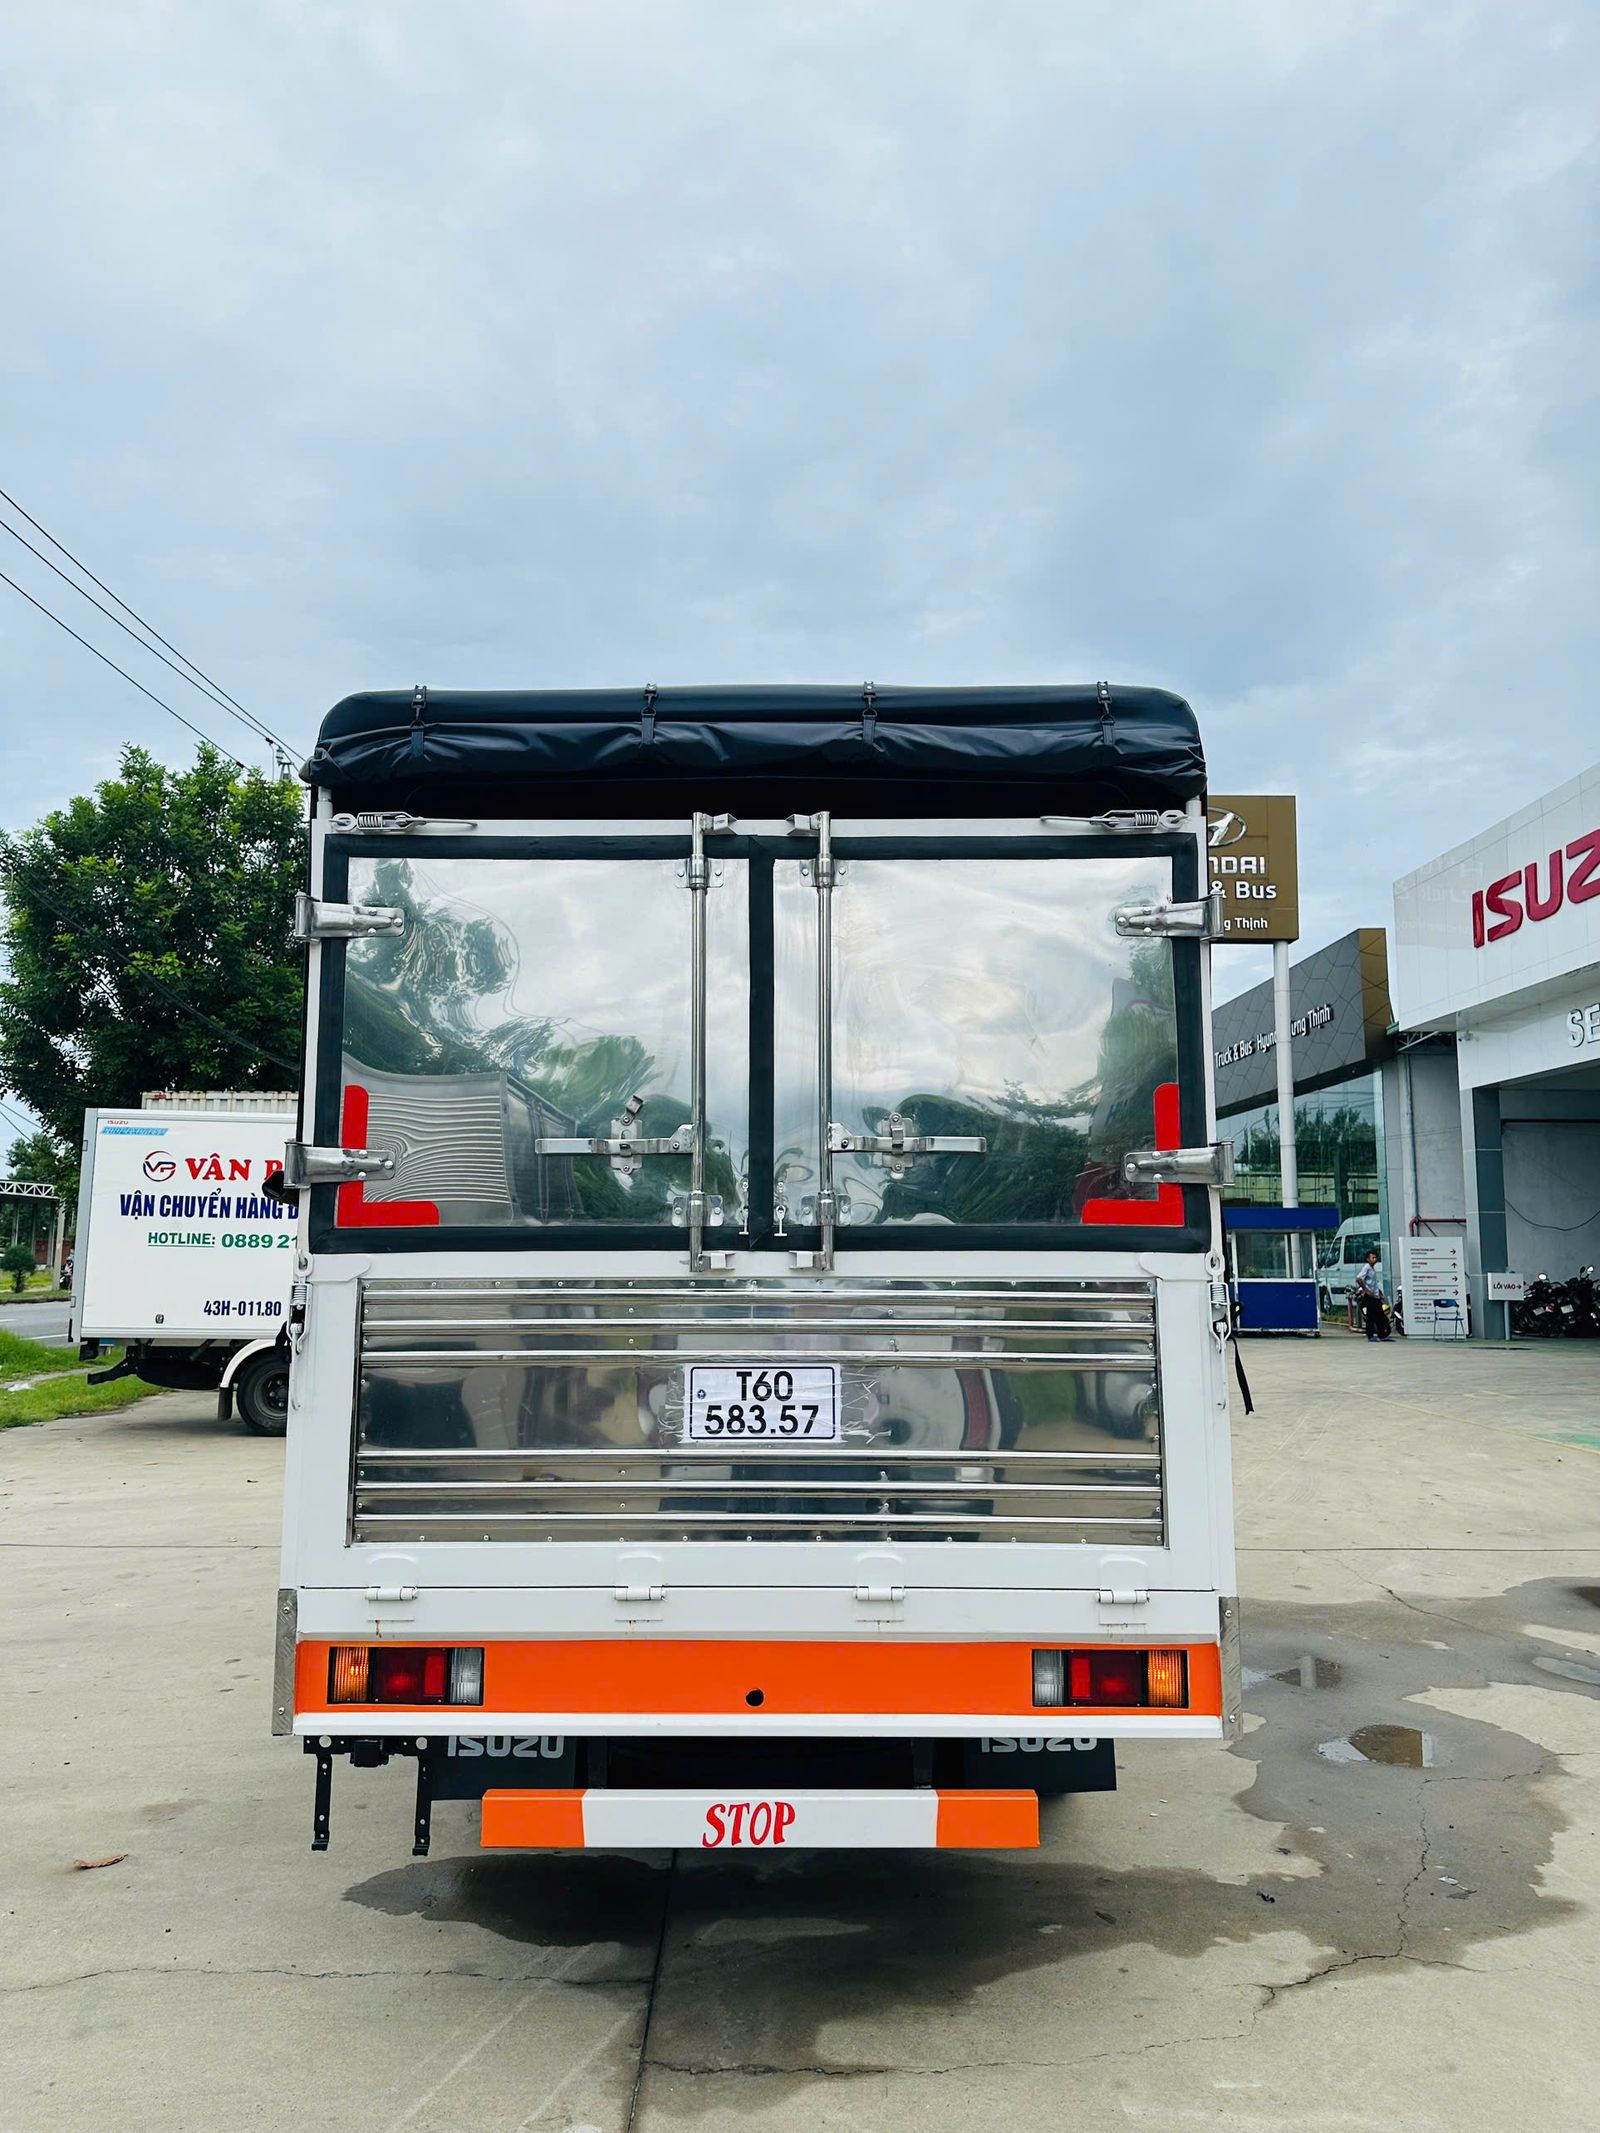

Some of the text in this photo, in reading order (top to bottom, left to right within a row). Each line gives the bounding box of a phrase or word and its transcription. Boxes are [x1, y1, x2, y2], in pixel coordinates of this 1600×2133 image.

[1210, 880, 1277, 899] & Bus
[1234, 917, 1268, 931] Thịnh
[1214, 1045, 1233, 1069] Truck
[1233, 1043, 1239, 1062] &
[1239, 1040, 1253, 1059] Bus
[1307, 1003, 1331, 1029] Thịnh
[184, 1152, 252, 1181] VÂN
[120, 1190, 156, 1220] VẬN
[159, 1187, 231, 1218] CHUYỂN
[235, 1192, 283, 1219] HÀNG
[148, 1232, 216, 1245] HOTLINE:
[221, 1233, 273, 1249] 0889
[203, 1300, 282, 1317] 43H-011.80
[736, 1370, 793, 1402] T60
[704, 1404, 819, 1436] 583.57
[447, 1735, 565, 1759] ISUZU
[702, 1800, 796, 1848] STOP
